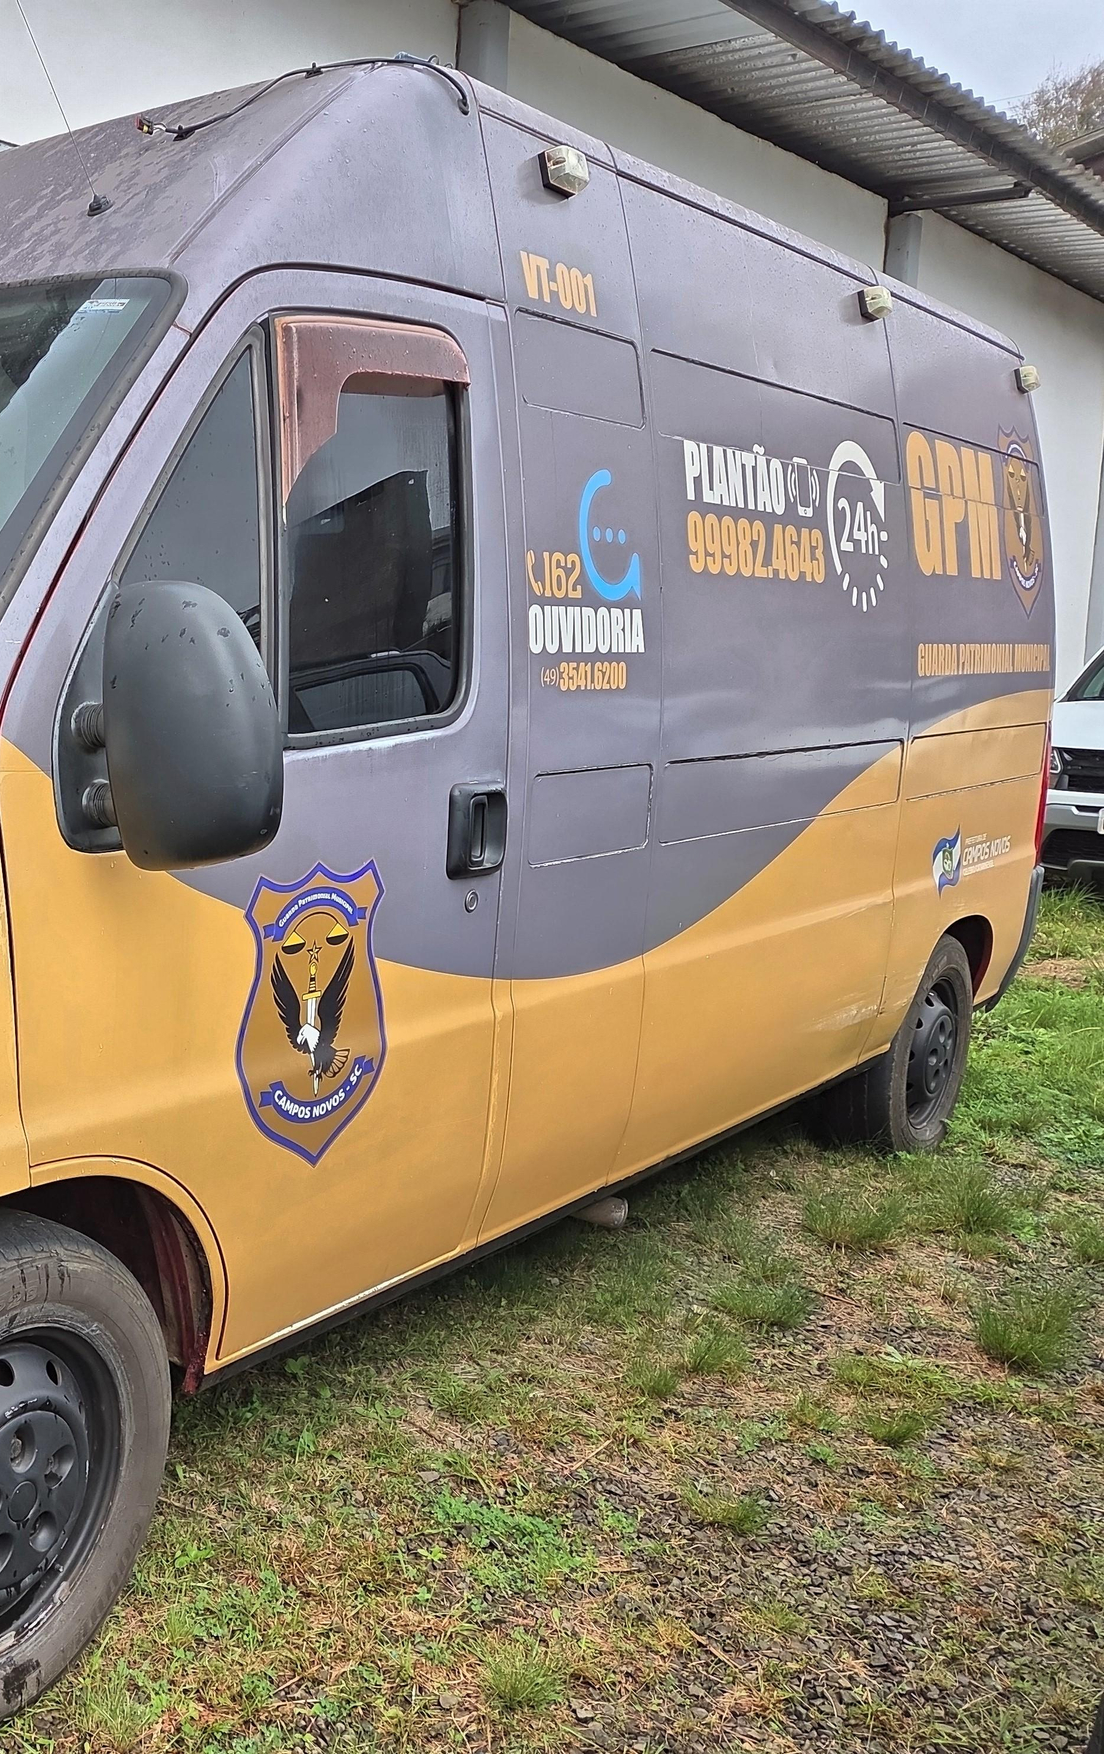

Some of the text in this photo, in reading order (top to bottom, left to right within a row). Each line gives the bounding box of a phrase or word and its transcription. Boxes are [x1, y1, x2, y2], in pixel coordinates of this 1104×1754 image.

[520, 250, 598, 318] VT-001
[684, 439, 786, 516] PLANTÃO
[905, 430, 1003, 581] GPM
[687, 510, 826, 584] 99982.4643
[837, 497, 880, 556] 24h
[543, 551, 583, 599] 162
[528, 604, 646, 654] OUVIDORIA
[917, 642, 1051, 677] GUARDA PATRIMONIAL MUNICIPAL
[962, 841, 991, 866] CAMPOS
[989, 834, 1012, 858] NOVOS
[274, 1089, 311, 1119] CAMPOS
[312, 1088, 346, 1118] NOVOS
[349, 1064, 363, 1086] SC
